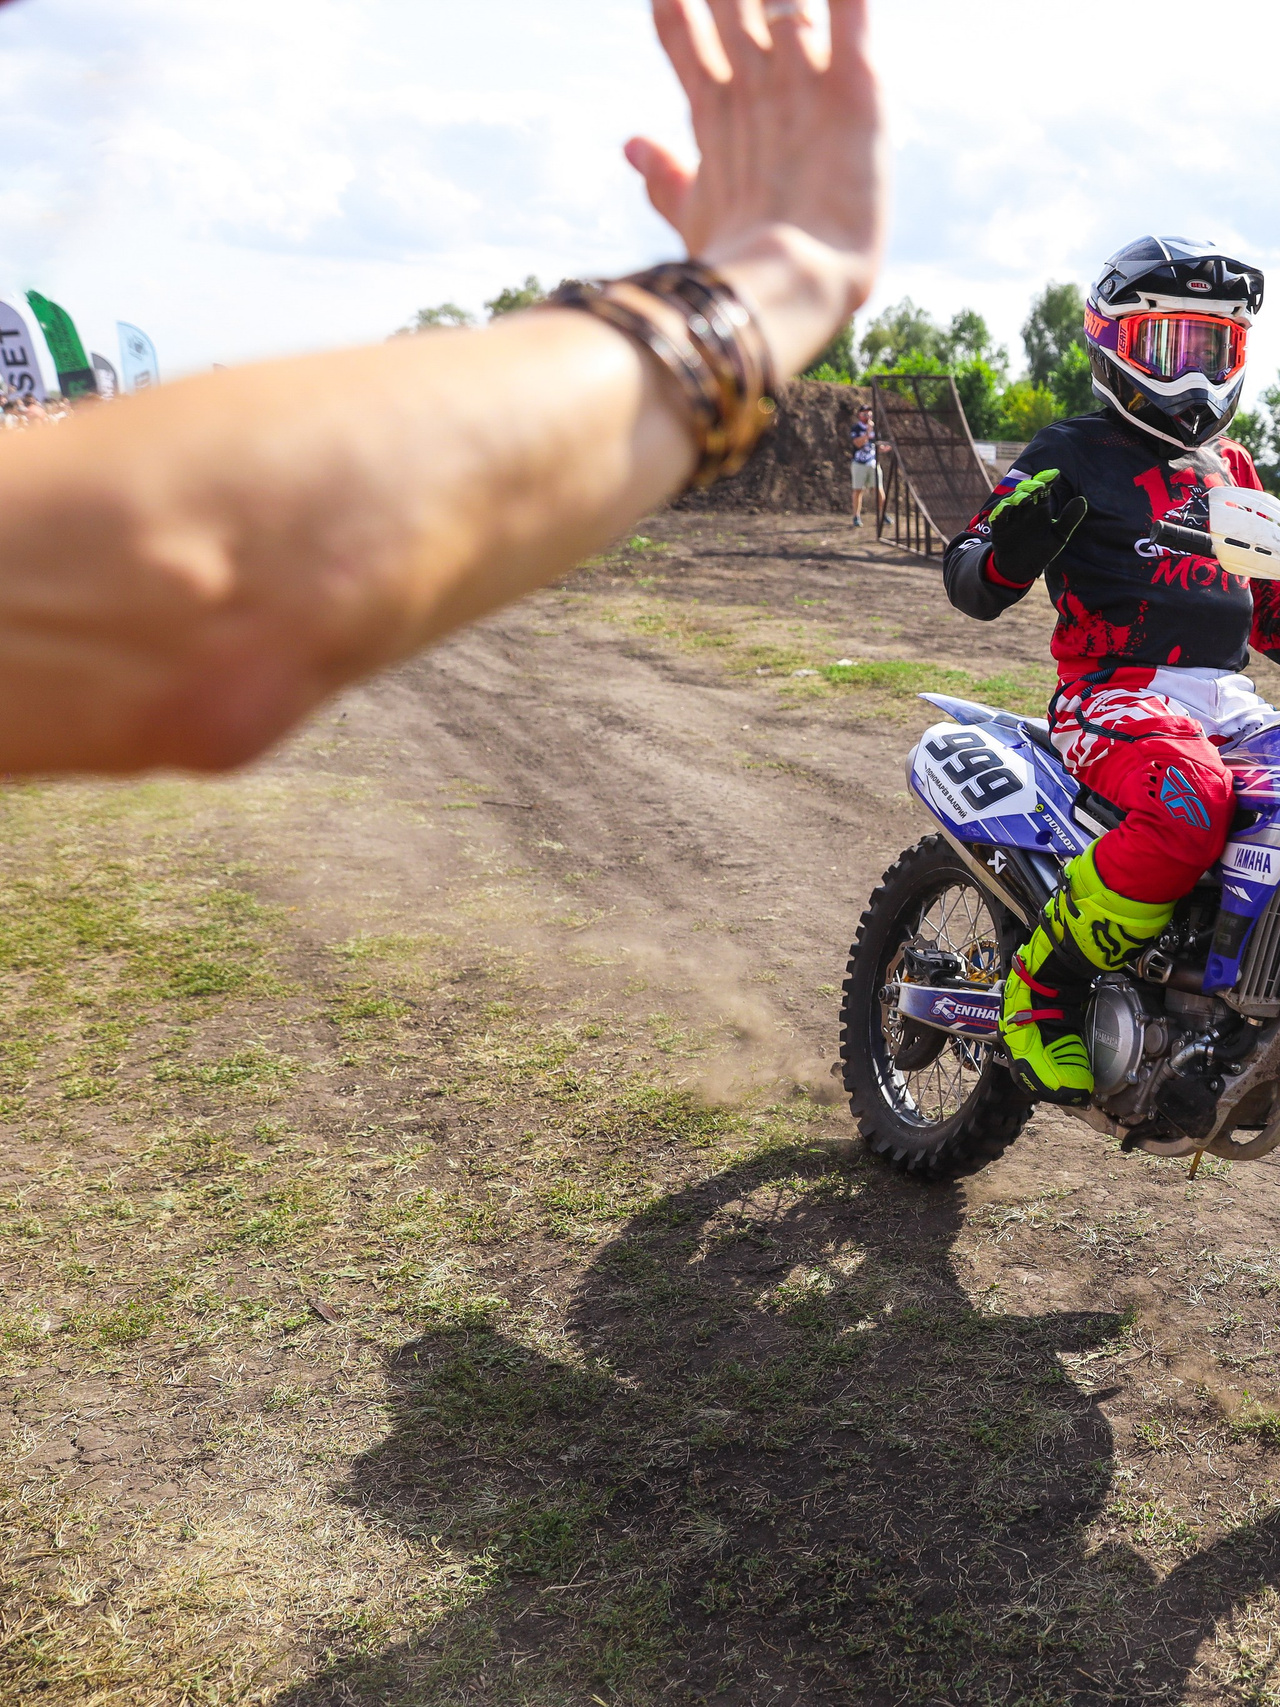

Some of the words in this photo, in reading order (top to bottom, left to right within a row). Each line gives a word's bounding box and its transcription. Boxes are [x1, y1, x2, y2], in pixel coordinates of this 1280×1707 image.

[1191, 282, 1208, 290] BELL
[1084, 306, 1110, 339] EATT
[1118, 324, 1128, 353] LEATT
[925, 732, 1024, 811] 999
[946, 794, 968, 819] ВАЛЕРИЙ
[1042, 813, 1077, 851] DUNLOP
[1234, 847, 1271, 873] YAMAHA
